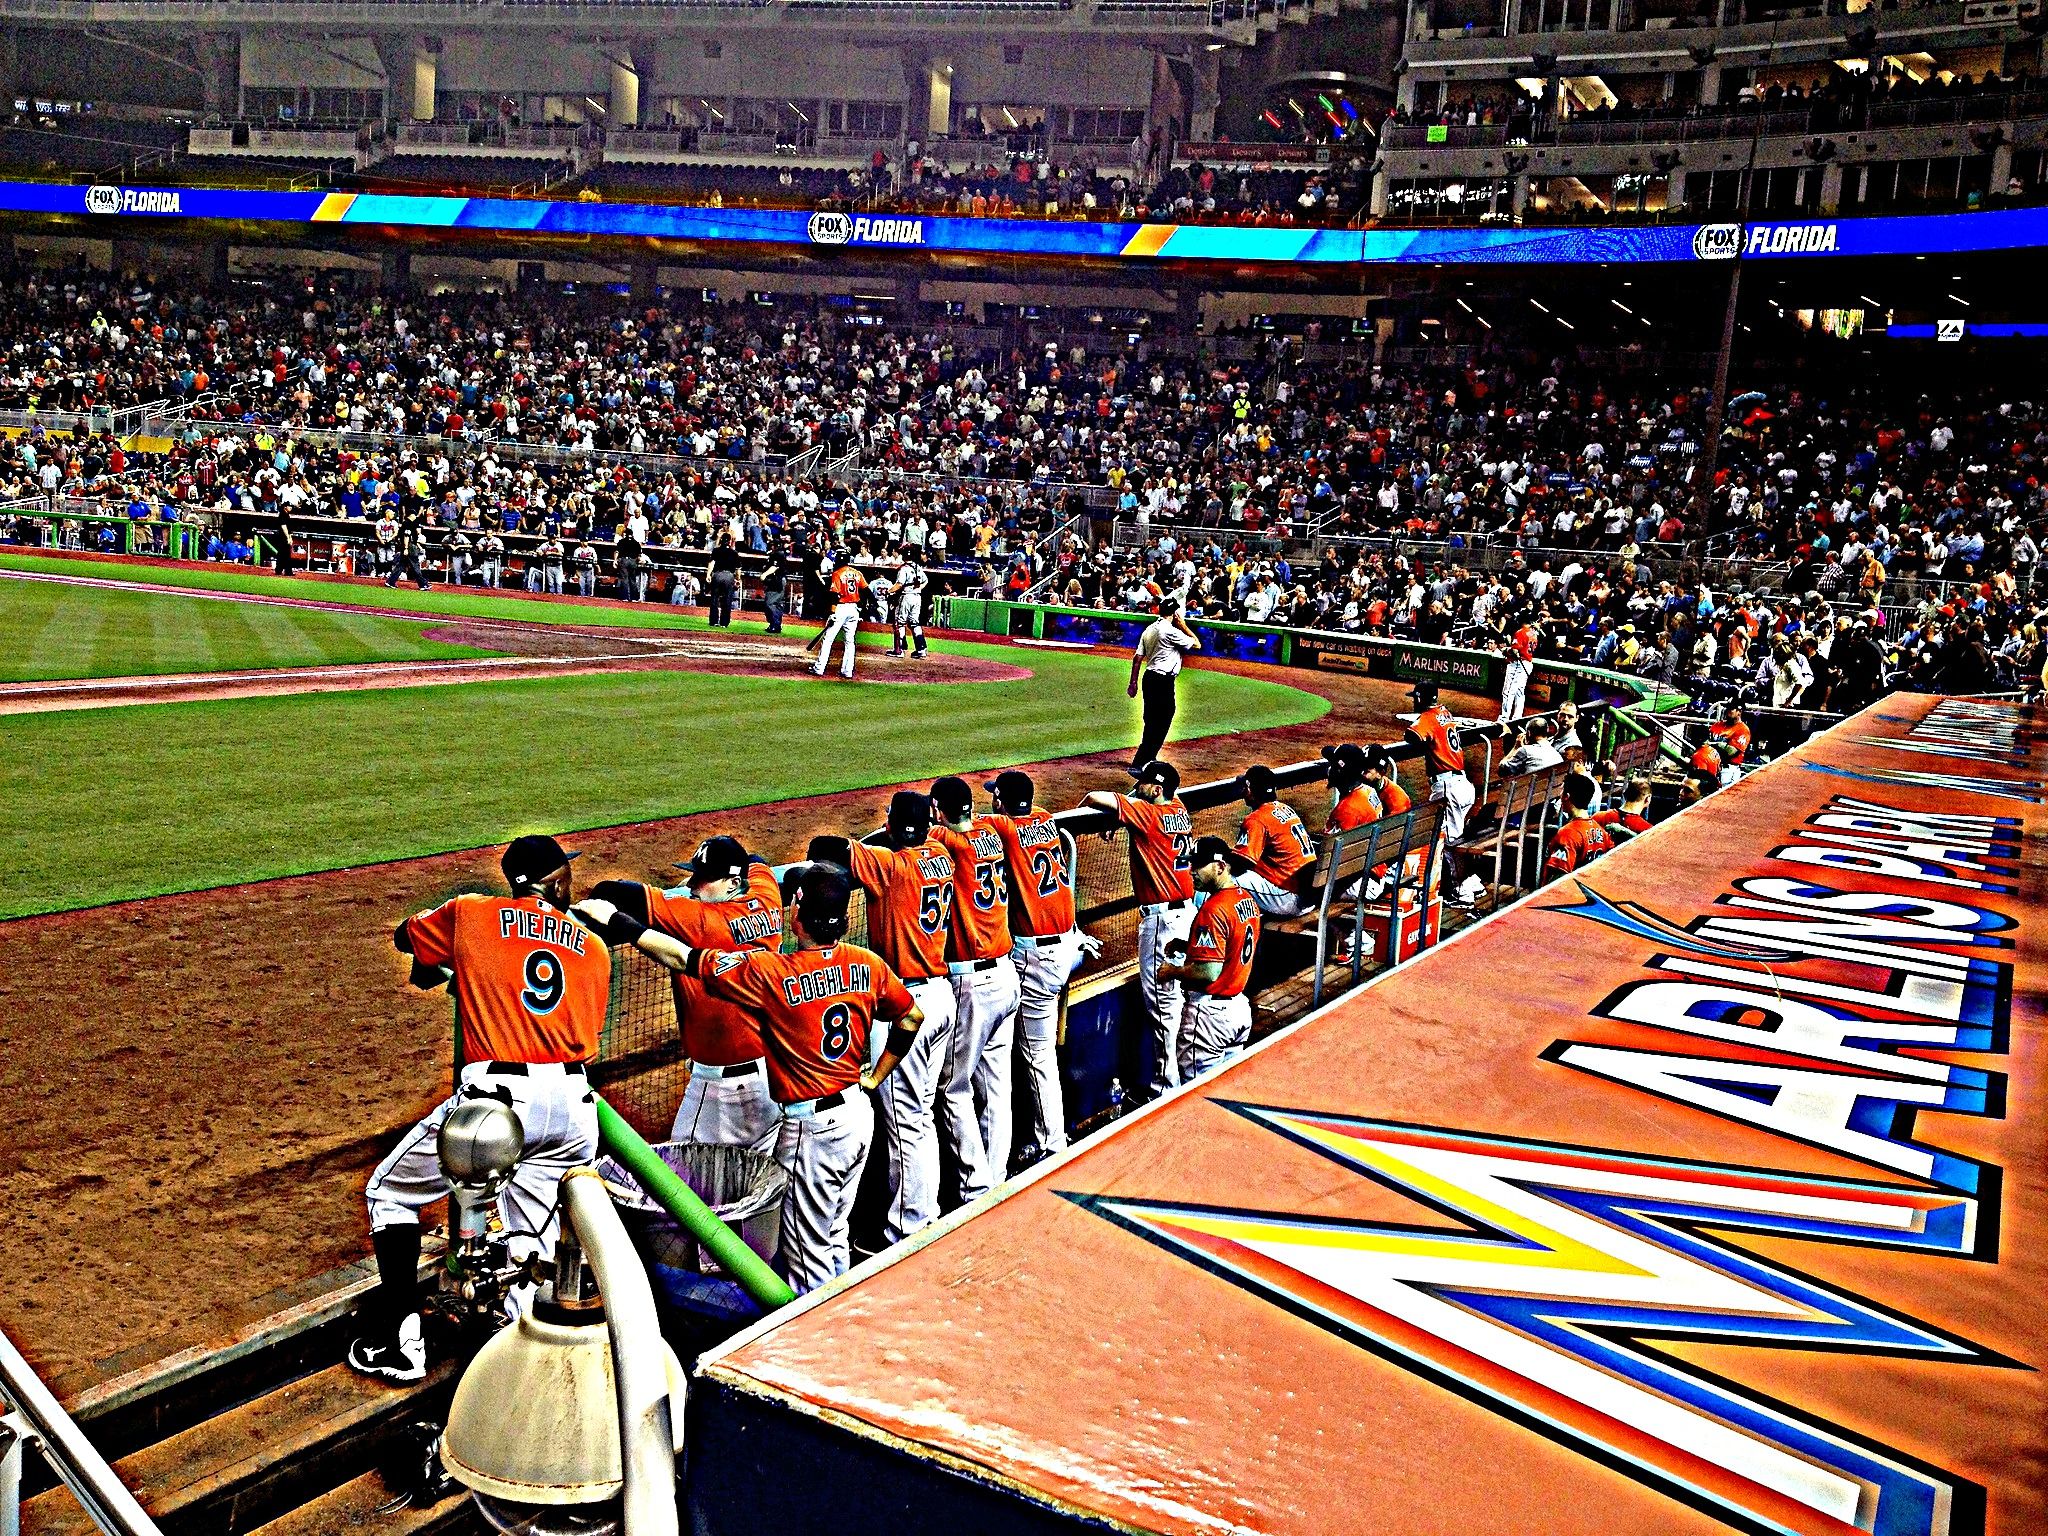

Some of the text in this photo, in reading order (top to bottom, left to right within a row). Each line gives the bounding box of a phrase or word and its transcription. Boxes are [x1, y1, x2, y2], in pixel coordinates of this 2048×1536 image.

[94, 189, 114, 204] FOX
[818, 216, 842, 233] FOX
[1704, 228, 1736, 247] FOX
[1704, 246, 1736, 255] SPORTS
[1325, 642, 1337, 651] car
[1367, 646, 1376, 655] on
[1376, 646, 1393, 657] deck
[1398, 651, 1481, 677] MARLINS PARK
[1764, 794, 2025, 897] PARK
[499, 907, 589, 957] PIERRE
[520, 948, 566, 1016] 9
[783, 962, 871, 1008] COGHLAN
[820, 1002, 852, 1062] 8
